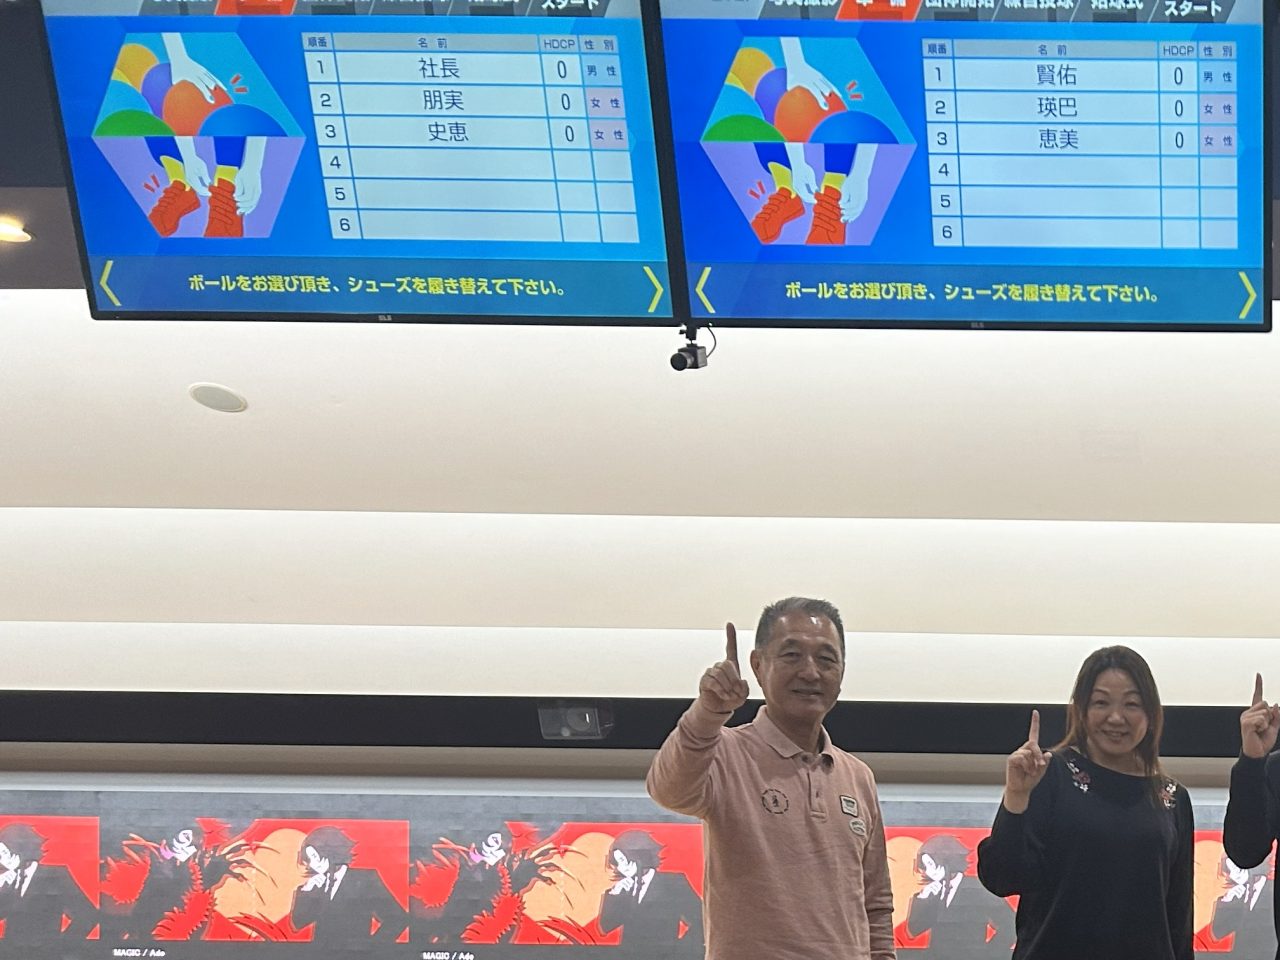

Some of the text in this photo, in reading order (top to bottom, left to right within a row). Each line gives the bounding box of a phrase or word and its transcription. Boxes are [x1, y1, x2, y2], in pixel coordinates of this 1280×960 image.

[1164, 0, 1222, 17] スタート
[307, 37, 615, 51] 順番 名前 HDCP 性別
[927, 43, 1233, 57] 順番 名前 HDCP 性別
[316, 57, 617, 80] 1 社長 0 男性
[935, 64, 1233, 87] 1 賢佑 0 男性
[319, 89, 621, 111] 2 朋実 0 女性
[935, 97, 1233, 118] 2 瑛巴 0 女性
[324, 121, 624, 143] 3 史恵 0 女性
[937, 128, 1233, 150] 3 恵美 0 女性
[329, 155, 342, 170] 4
[938, 162, 950, 177] 4
[334, 187, 346, 202] 5
[940, 194, 951, 209] 5
[339, 218, 351, 232] 6
[941, 225, 953, 240] 6
[188, 274, 566, 297] ボールをお選び頂き、シューズを履き替えて下さい。
[785, 281, 1160, 304] ボールをお選び頂き、シューズを履き替えて下さい。
[113, 949, 141, 957] MAGIC
[422, 952, 450, 960] MAGIC
